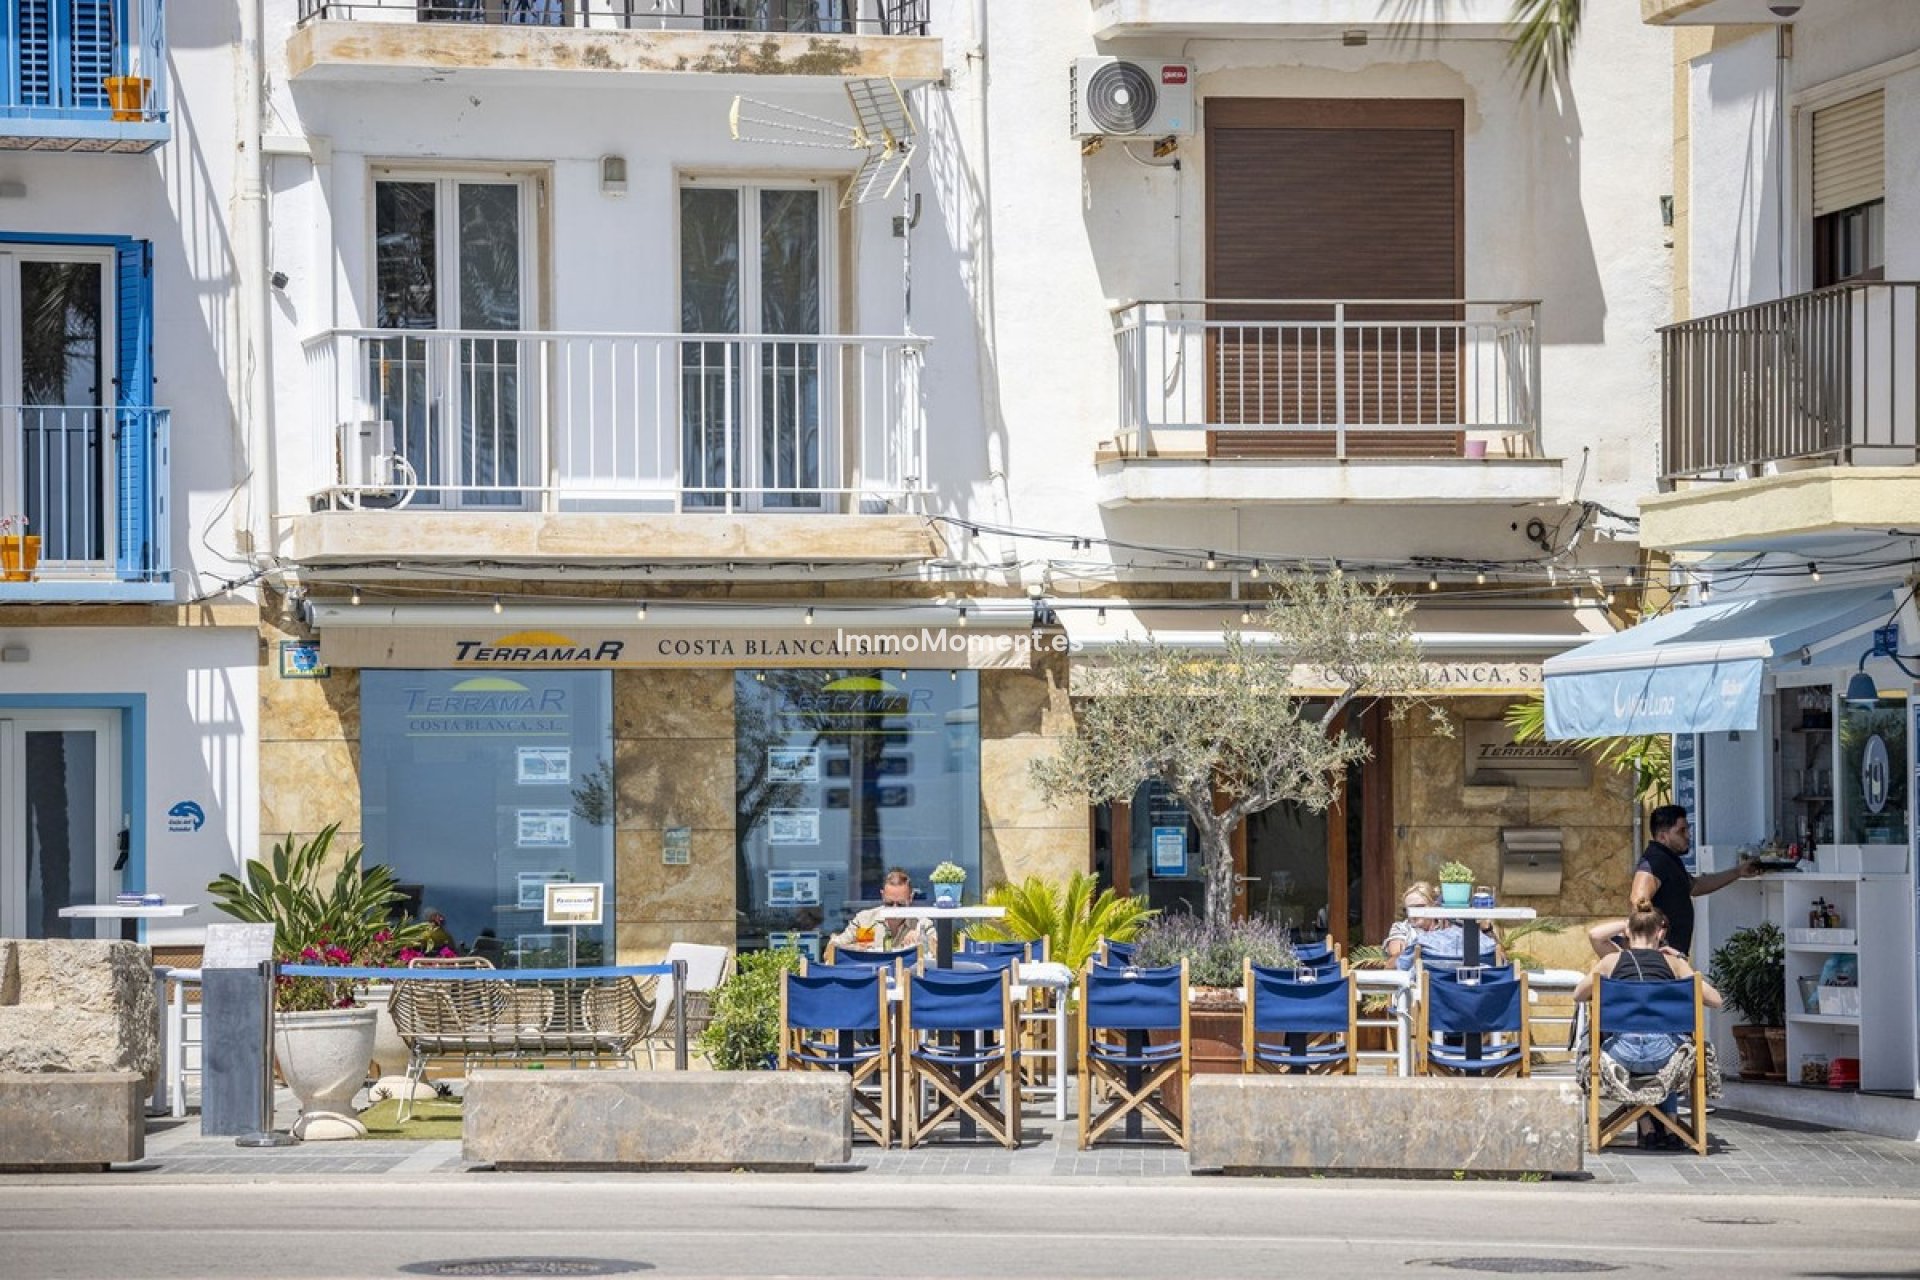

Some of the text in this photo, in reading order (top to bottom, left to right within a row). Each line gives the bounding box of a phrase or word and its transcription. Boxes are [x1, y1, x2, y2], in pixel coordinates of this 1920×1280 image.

[456, 640, 624, 661] TERRAMAR
[658, 639, 734, 655] COSTA
[745, 639, 848, 657] BLANCA,
[1409, 666, 1511, 683] LANCA,
[403, 688, 566, 712] TERRAMAR
[409, 719, 563, 732] COSTA BLANCA, S.L.
